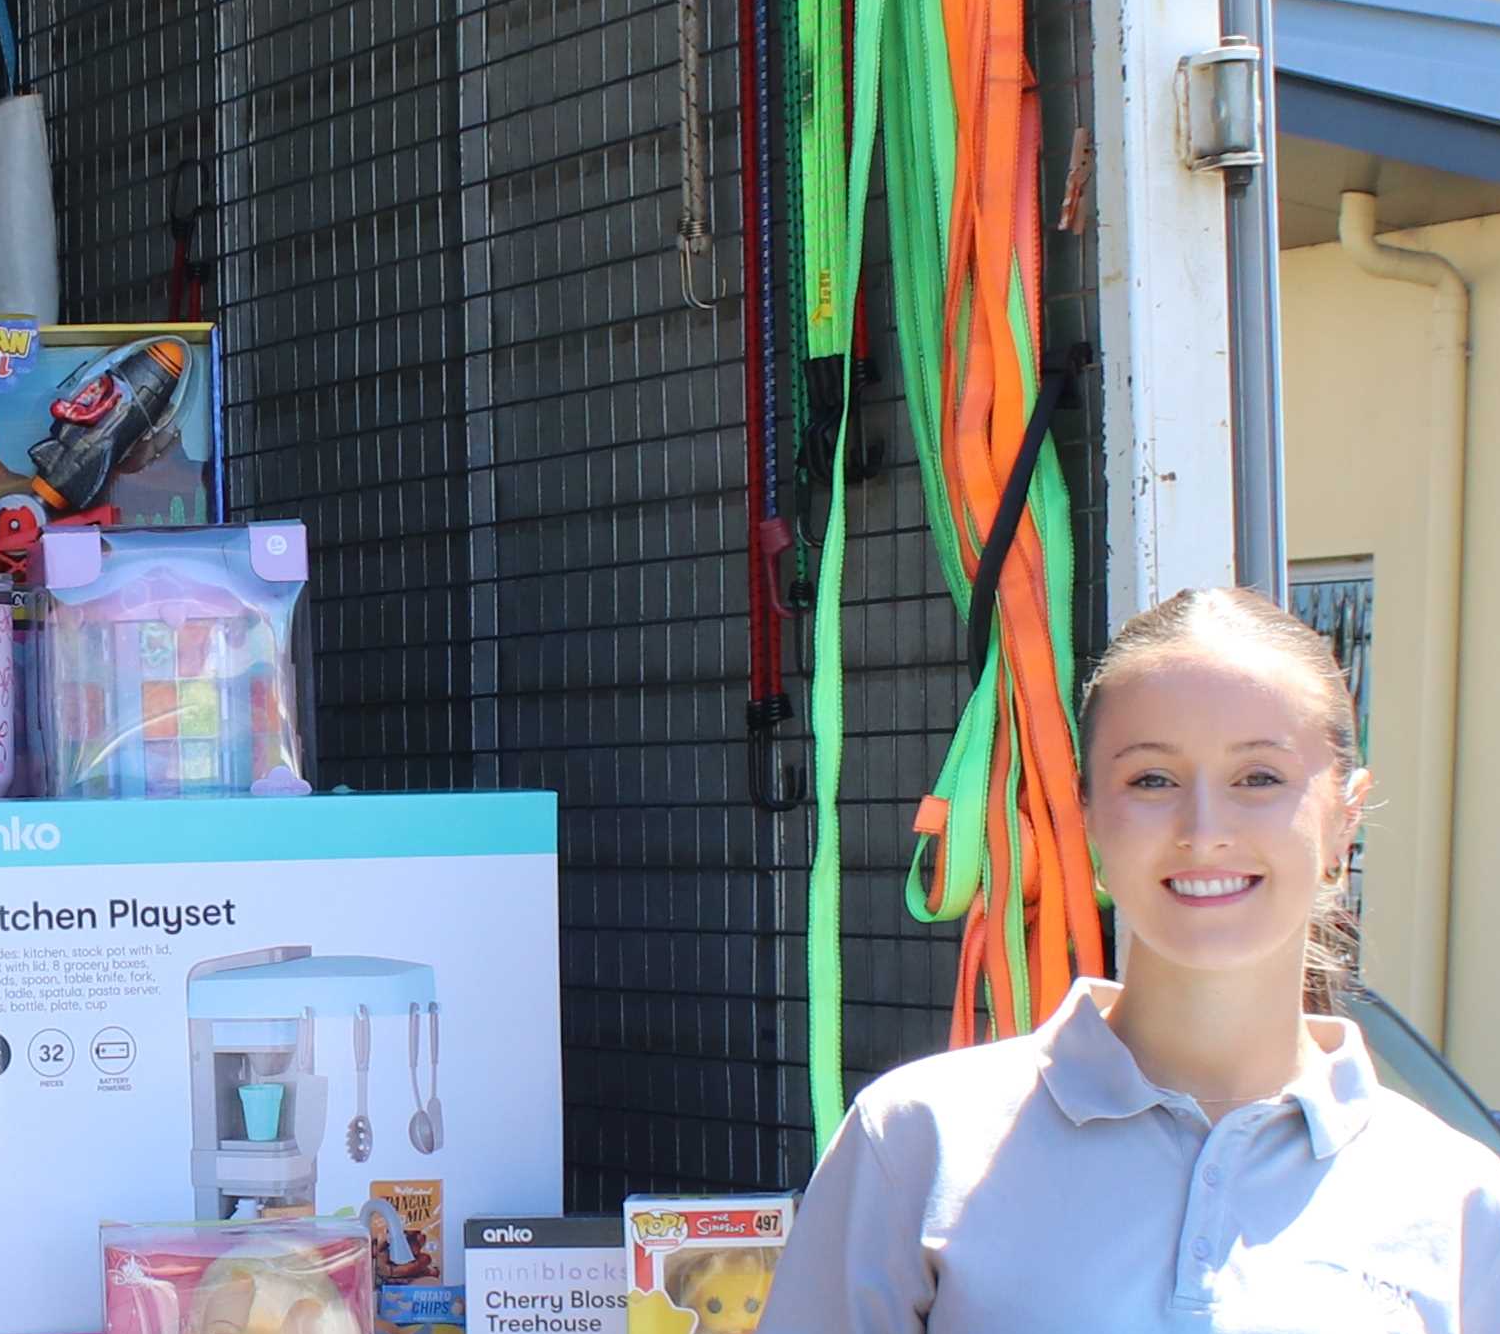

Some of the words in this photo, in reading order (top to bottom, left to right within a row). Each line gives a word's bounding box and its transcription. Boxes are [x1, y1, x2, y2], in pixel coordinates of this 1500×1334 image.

[108, 898, 237, 935] Playset
[71, 945, 102, 958] stock
[106, 945, 126, 960] pot
[129, 944, 153, 956] with
[156, 943, 172, 957] lid,
[5, 960, 29, 972] with
[32, 960, 49, 974] lid,
[52, 960, 61, 971] 8
[63, 961, 110, 974] grocery
[112, 957, 149, 971] boxes,
[21, 974, 60, 989] spoon,
[96, 971, 126, 984] knife,
[129, 970, 156, 984] fork,
[4, 987, 36, 1000] ladle,
[39, 985, 86, 1000] spatula,
[88, 985, 121, 999] pasta
[123, 985, 161, 997] server,
[10, 999, 47, 1013] bottle,
[50, 999, 83, 1013] plate,
[86, 1000, 108, 1013] cup
[39, 1044, 64, 1062] 32
[632, 1211, 687, 1238] POP!
[755, 1215, 779, 1231] 497
[482, 1225, 533, 1243] anko
[413, 1290, 452, 1302] POTATO
[486, 1290, 563, 1313] Cherry
[571, 1290, 628, 1309] Bloss
[411, 1301, 450, 1315] CHIPS
[486, 1314, 603, 1333] Treehouse
